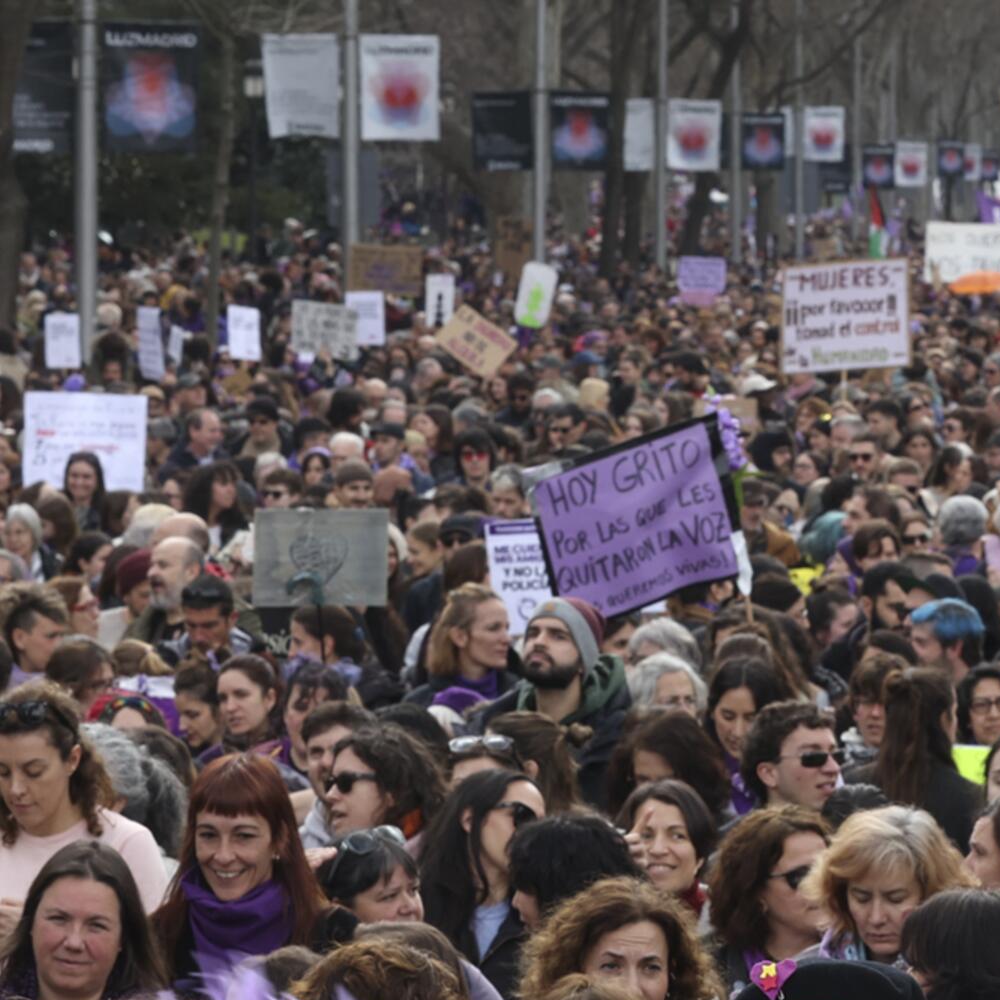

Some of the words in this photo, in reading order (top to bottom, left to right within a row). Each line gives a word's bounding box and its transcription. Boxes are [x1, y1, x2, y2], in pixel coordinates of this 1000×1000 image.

[548, 468, 598, 517] HOY
[551, 528, 590, 559] POR
[595, 517, 630, 544] LAS
[635, 498, 667, 528] QUE
[677, 483, 717, 508] LES
[657, 530, 682, 552] LA
[680, 512, 730, 546] VOZ
[503, 567, 511, 577] Y
[514, 566, 533, 577] NO
